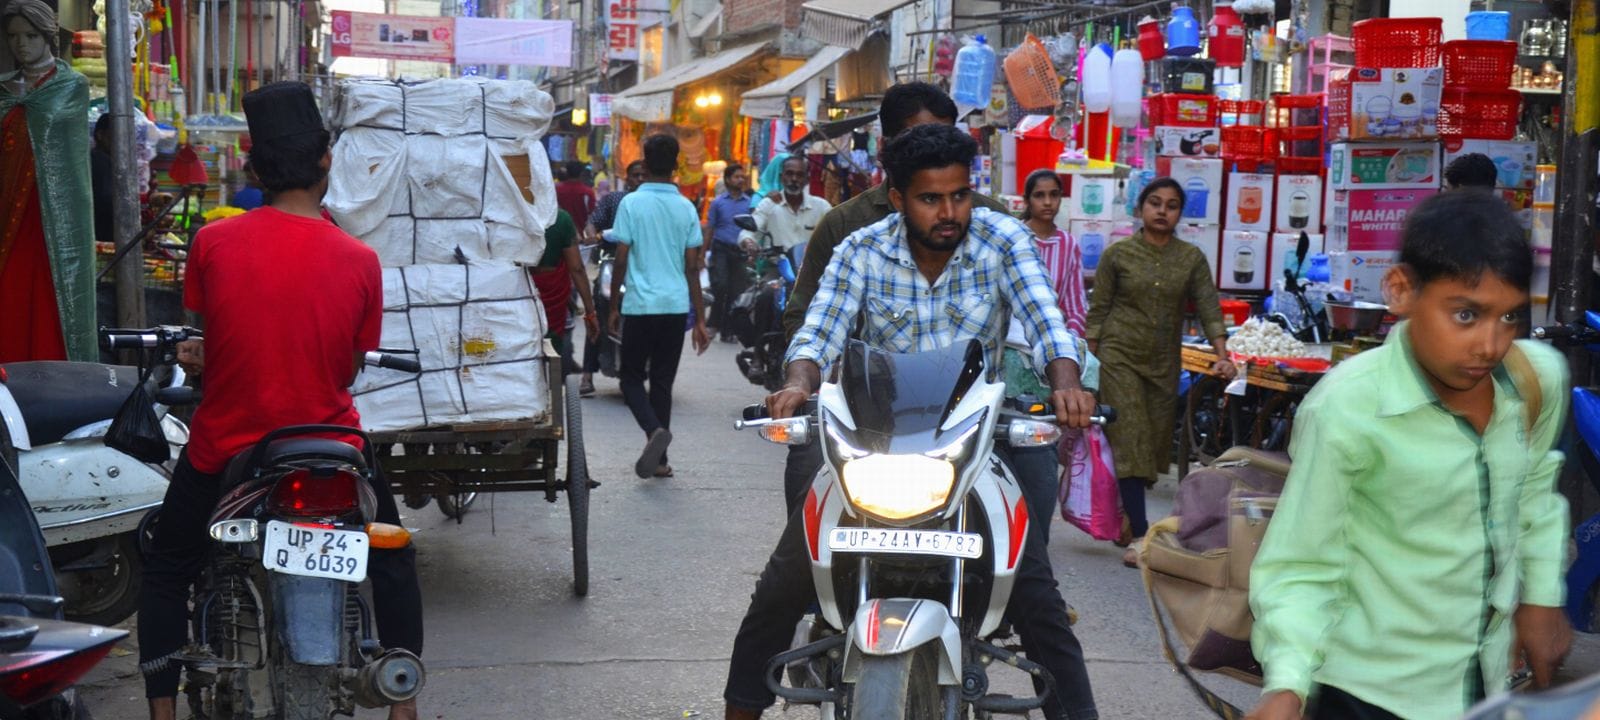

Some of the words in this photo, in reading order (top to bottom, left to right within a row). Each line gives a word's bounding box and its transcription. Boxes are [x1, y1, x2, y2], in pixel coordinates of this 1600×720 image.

[332, 32, 351, 45] LG
[287, 528, 314, 548] UP
[322, 532, 348, 551] 24
[276, 548, 289, 568] Q
[305, 553, 358, 575] 6039
